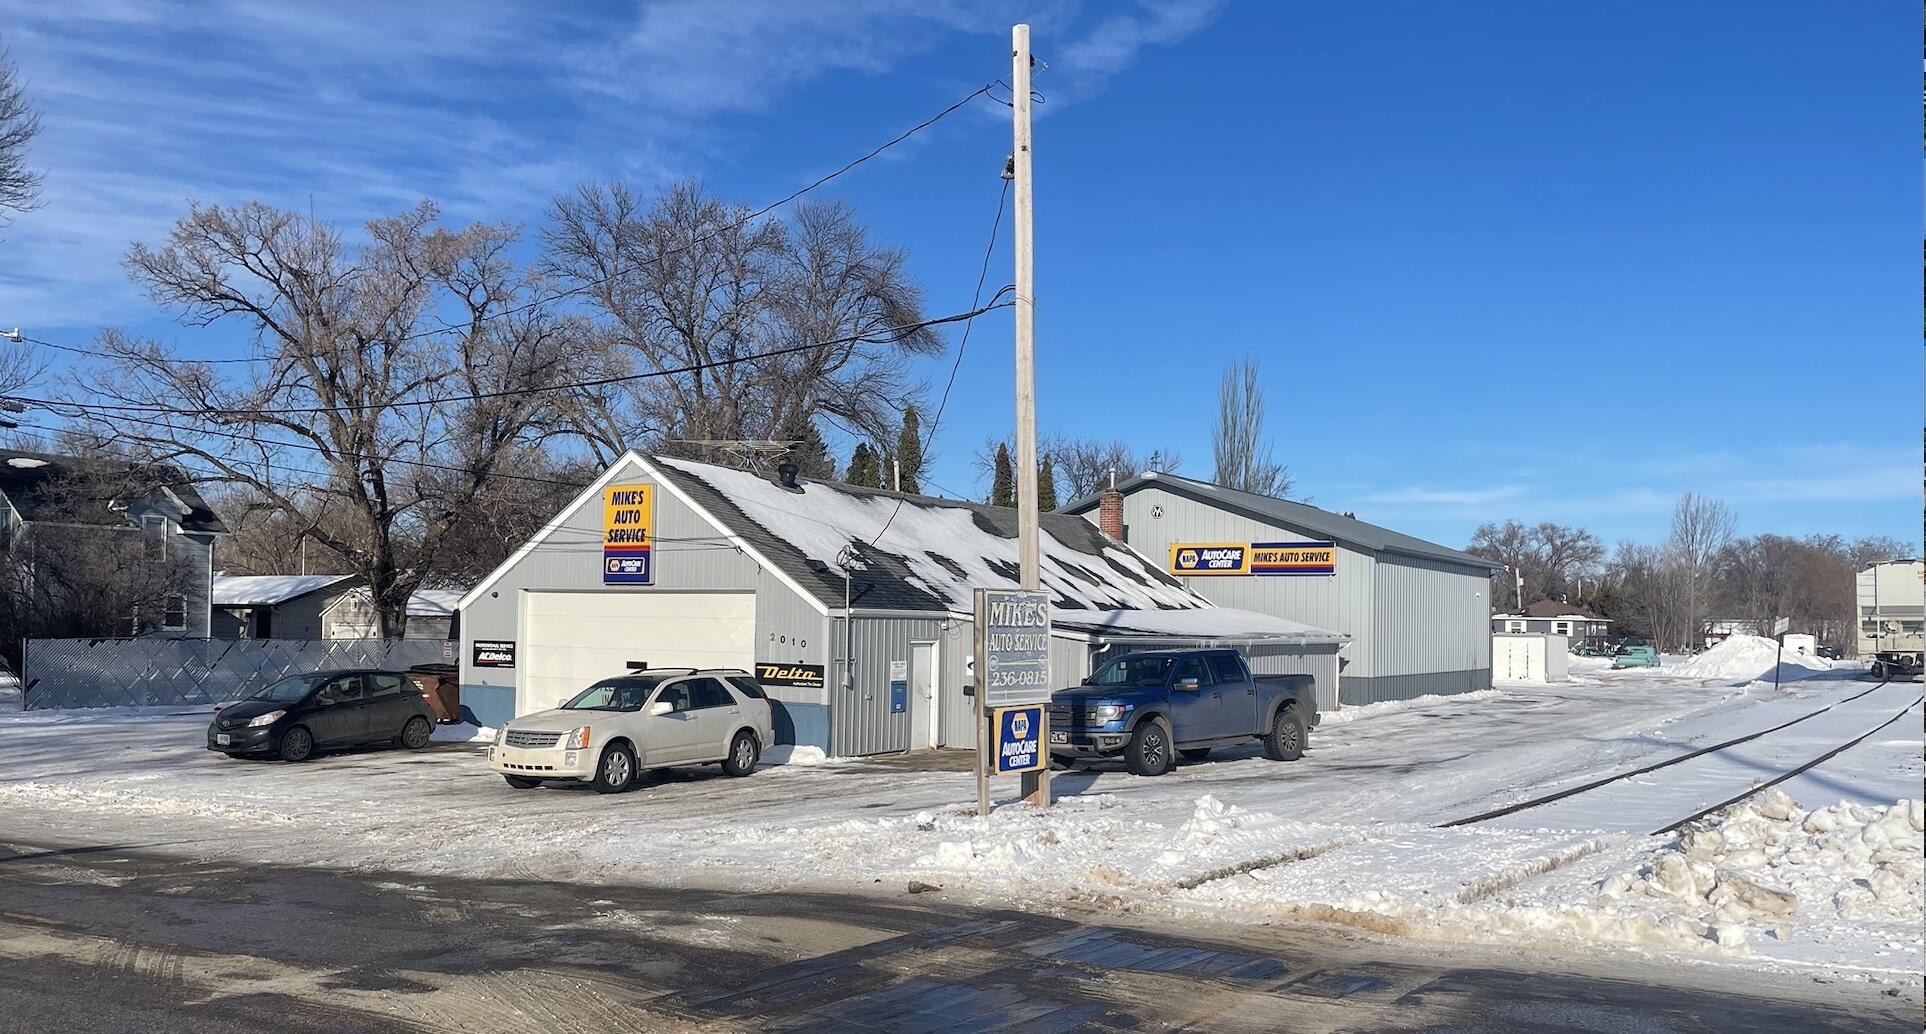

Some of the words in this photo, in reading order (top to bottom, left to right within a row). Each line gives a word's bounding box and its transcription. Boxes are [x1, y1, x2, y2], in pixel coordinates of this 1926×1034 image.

[612, 490, 644, 506] MIKE'S
[614, 510, 640, 524] AUTO
[608, 528, 646, 543] SERVICE
[1201, 549, 1241, 560] AUTOCARE
[1254, 552, 1278, 562] MIKE'S
[1280, 552, 1299, 562] AUTO
[1301, 552, 1330, 562] SERVICE
[1208, 559, 1233, 568] CENTER
[770, 633, 807, 648] 2010
[989, 633, 1013, 651] AUTO
[1014, 633, 1047, 651] SERVICE
[478, 652, 512, 661] ACDelco
[757, 666, 823, 680] Delta
[992, 670, 1047, 686] 236-0815
[1002, 740, 1037, 757] AUTOCARE
[1009, 754, 1031, 768] CENTER
